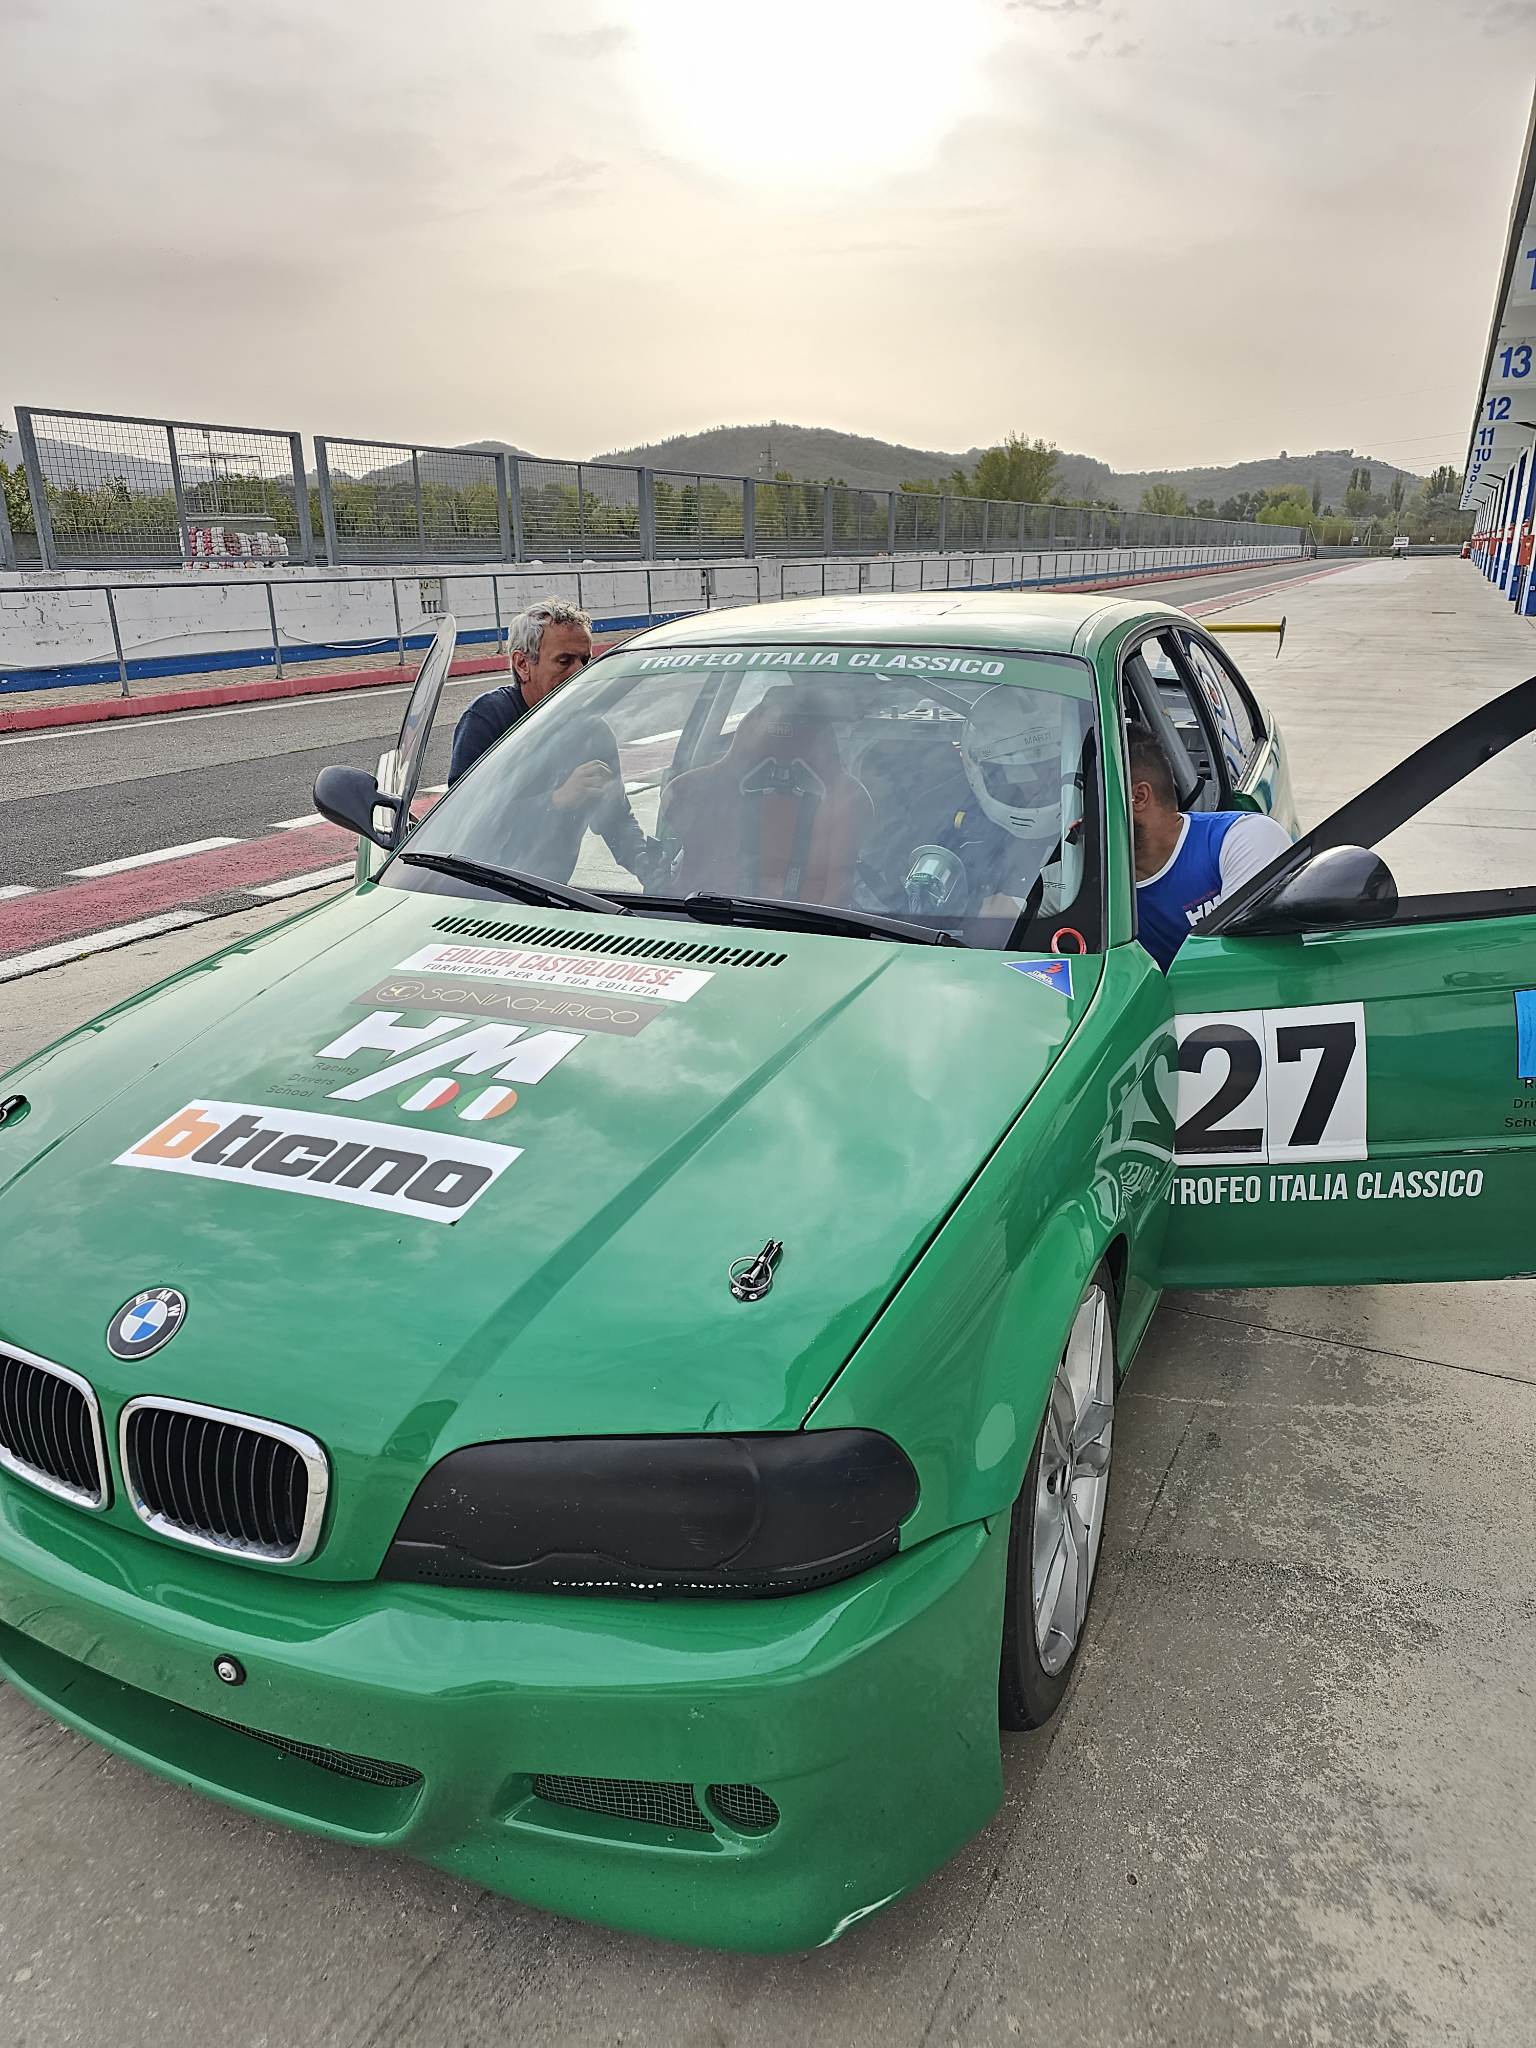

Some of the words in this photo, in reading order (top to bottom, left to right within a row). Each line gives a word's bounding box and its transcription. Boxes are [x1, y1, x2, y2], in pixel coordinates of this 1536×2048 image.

[1500, 344, 1532, 378] 13
[1486, 396, 1511, 420] 12
[1479, 427, 1495, 446] 11
[1475, 448, 1491, 461] 10
[639, 652, 743, 671] TROFEO
[746, 652, 839, 667] ITALIA
[848, 653, 1005, 677] CLASSICO
[433, 947, 523, 968] EDILIZIA
[518, 953, 683, 986] CASTIGLIONESE
[504, 970, 534, 979] PER
[539, 973, 553, 982] LA
[563, 976, 590, 986] TUA
[596, 980, 660, 995] EDILIZIA
[288, 1073, 335, 1085] Drivers
[312, 1062, 359, 1076] Racing
[265, 1085, 315, 1097] School
[1175, 1021, 1357, 1155] 27
[131, 1108, 493, 1208] bticino
[1170, 1175, 1261, 1206] TROFEO
[1269, 1172, 1349, 1202] ITALIA
[1356, 1169, 1484, 1199] CLASSICO
[136, 1289, 181, 1317] BMW
